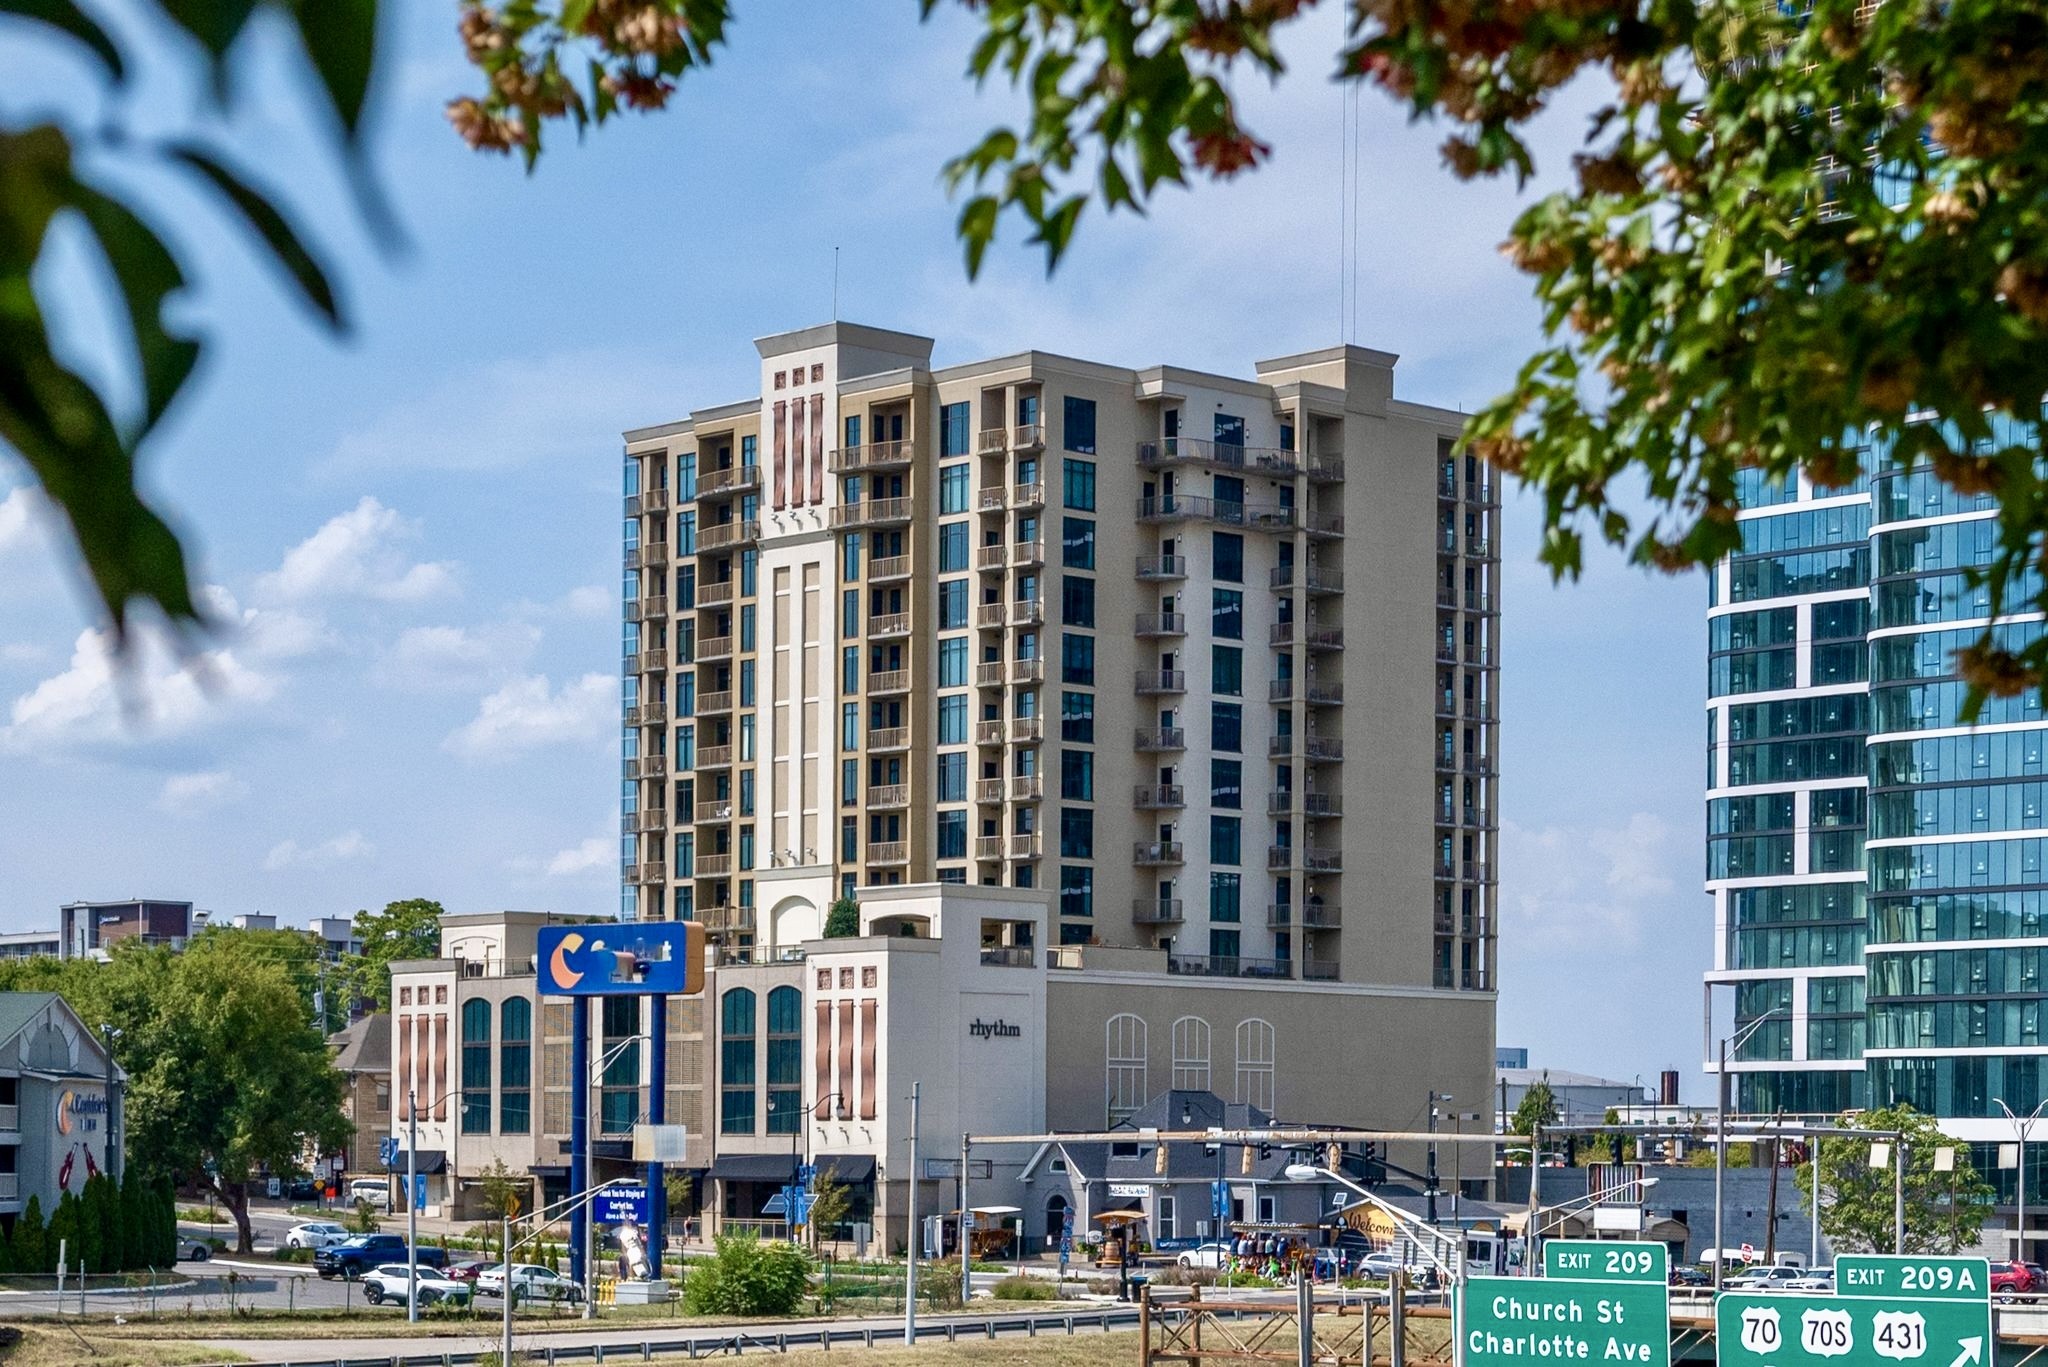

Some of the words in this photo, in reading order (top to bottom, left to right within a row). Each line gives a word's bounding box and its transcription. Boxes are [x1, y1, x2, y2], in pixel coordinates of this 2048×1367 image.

[969, 1018, 1021, 1040] rhythm
[1558, 1253, 1591, 1269] EXIT
[1605, 1251, 1653, 1274] 209
[1847, 1268, 1885, 1285] EXIT
[1900, 1266, 1976, 1291] 209A
[1492, 1296, 1583, 1323] Church
[1597, 1300, 1624, 1325] St
[1746, 1318, 1777, 1345] 70
[1807, 1320, 1847, 1346] 70S
[1878, 1323, 1922, 1350] 431
[1469, 1330, 1589, 1358] Charlotte
[1603, 1336, 1651, 1362] Ave
